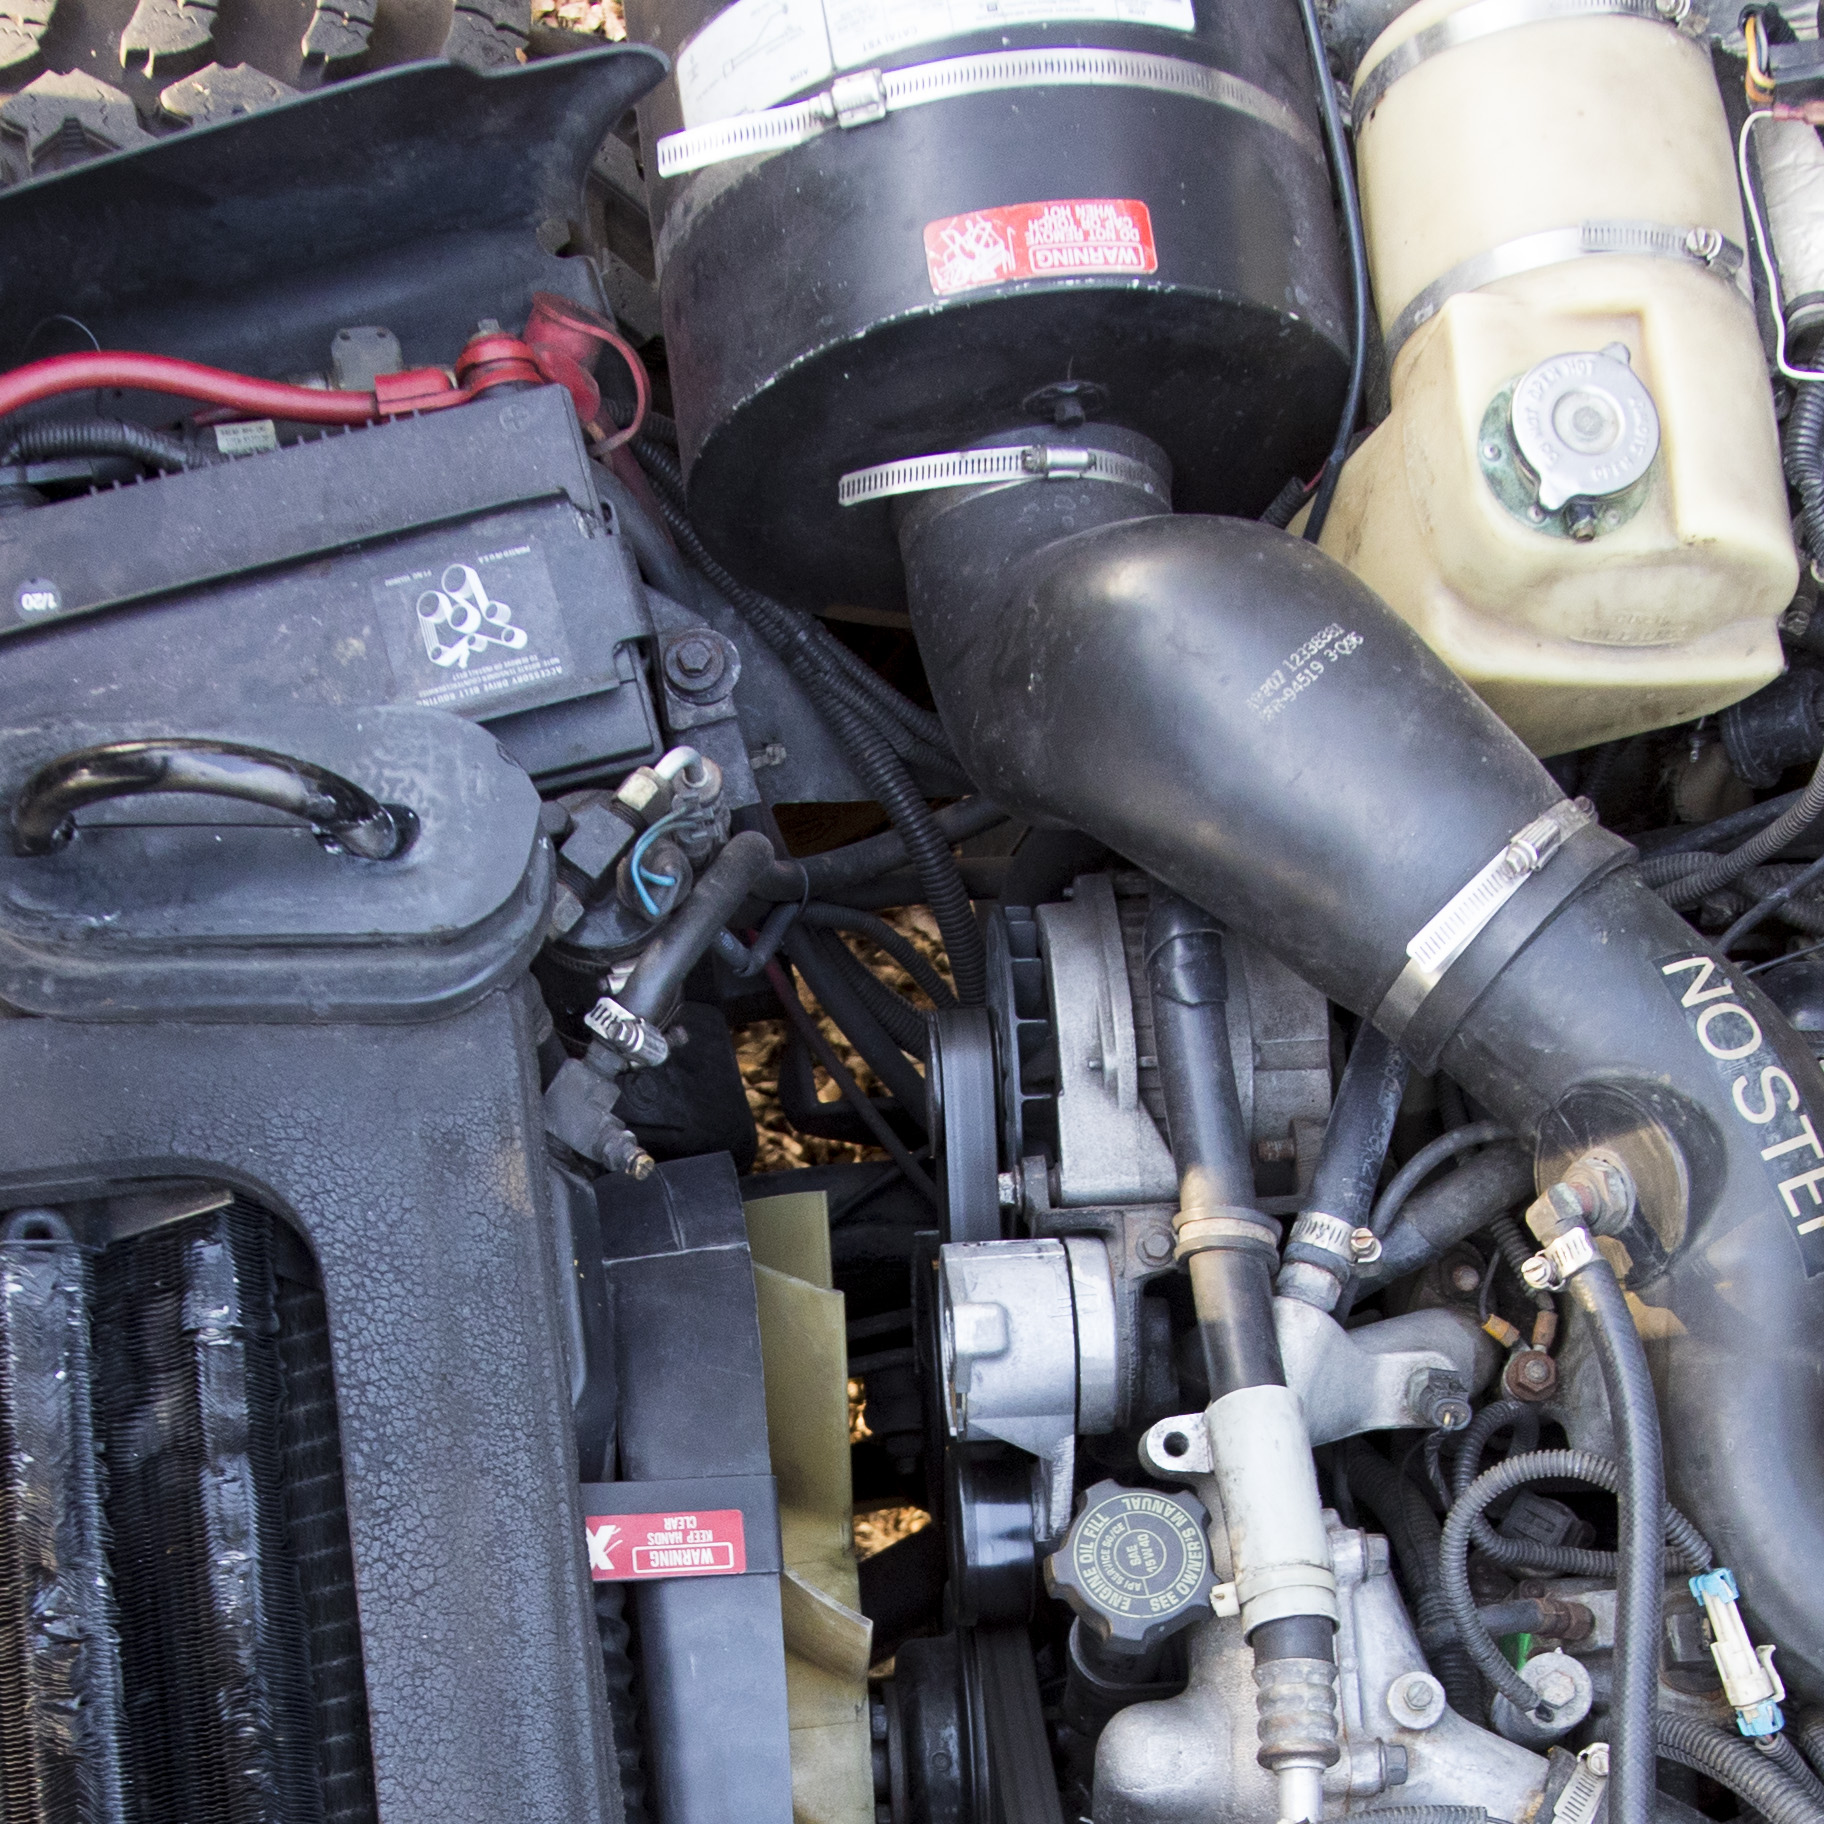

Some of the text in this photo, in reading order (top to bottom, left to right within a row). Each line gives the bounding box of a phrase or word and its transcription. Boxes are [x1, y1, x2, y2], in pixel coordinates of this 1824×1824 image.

[1042, 202, 1116, 221] WHEN HOT
[1027, 214, 1132, 234] CAP OR TOUCH
[1024, 226, 1139, 244] DO NOT REMOVE
[1034, 243, 1138, 270] WARNING
[1564, 359, 1596, 376] HOT
[21, 592, 58, 611] 1/20
[511, 664, 562, 685] ACCESSORY
[457, 685, 480, 698] BELT
[482, 678, 508, 692] DRIVE
[663, 1515, 697, 1530] CLEAR
[646, 1528, 713, 1546] KEEP HANDS
[648, 1545, 714, 1568] WARNING
[1079, 1512, 1131, 1611] ENGINE OIL FILL
[1100, 1521, 1142, 1591] API SERVICE SG/CE
[1121, 1496, 1202, 1611] SEE OWNER'S MANUAL
[1125, 1544, 1142, 1566] SAE
